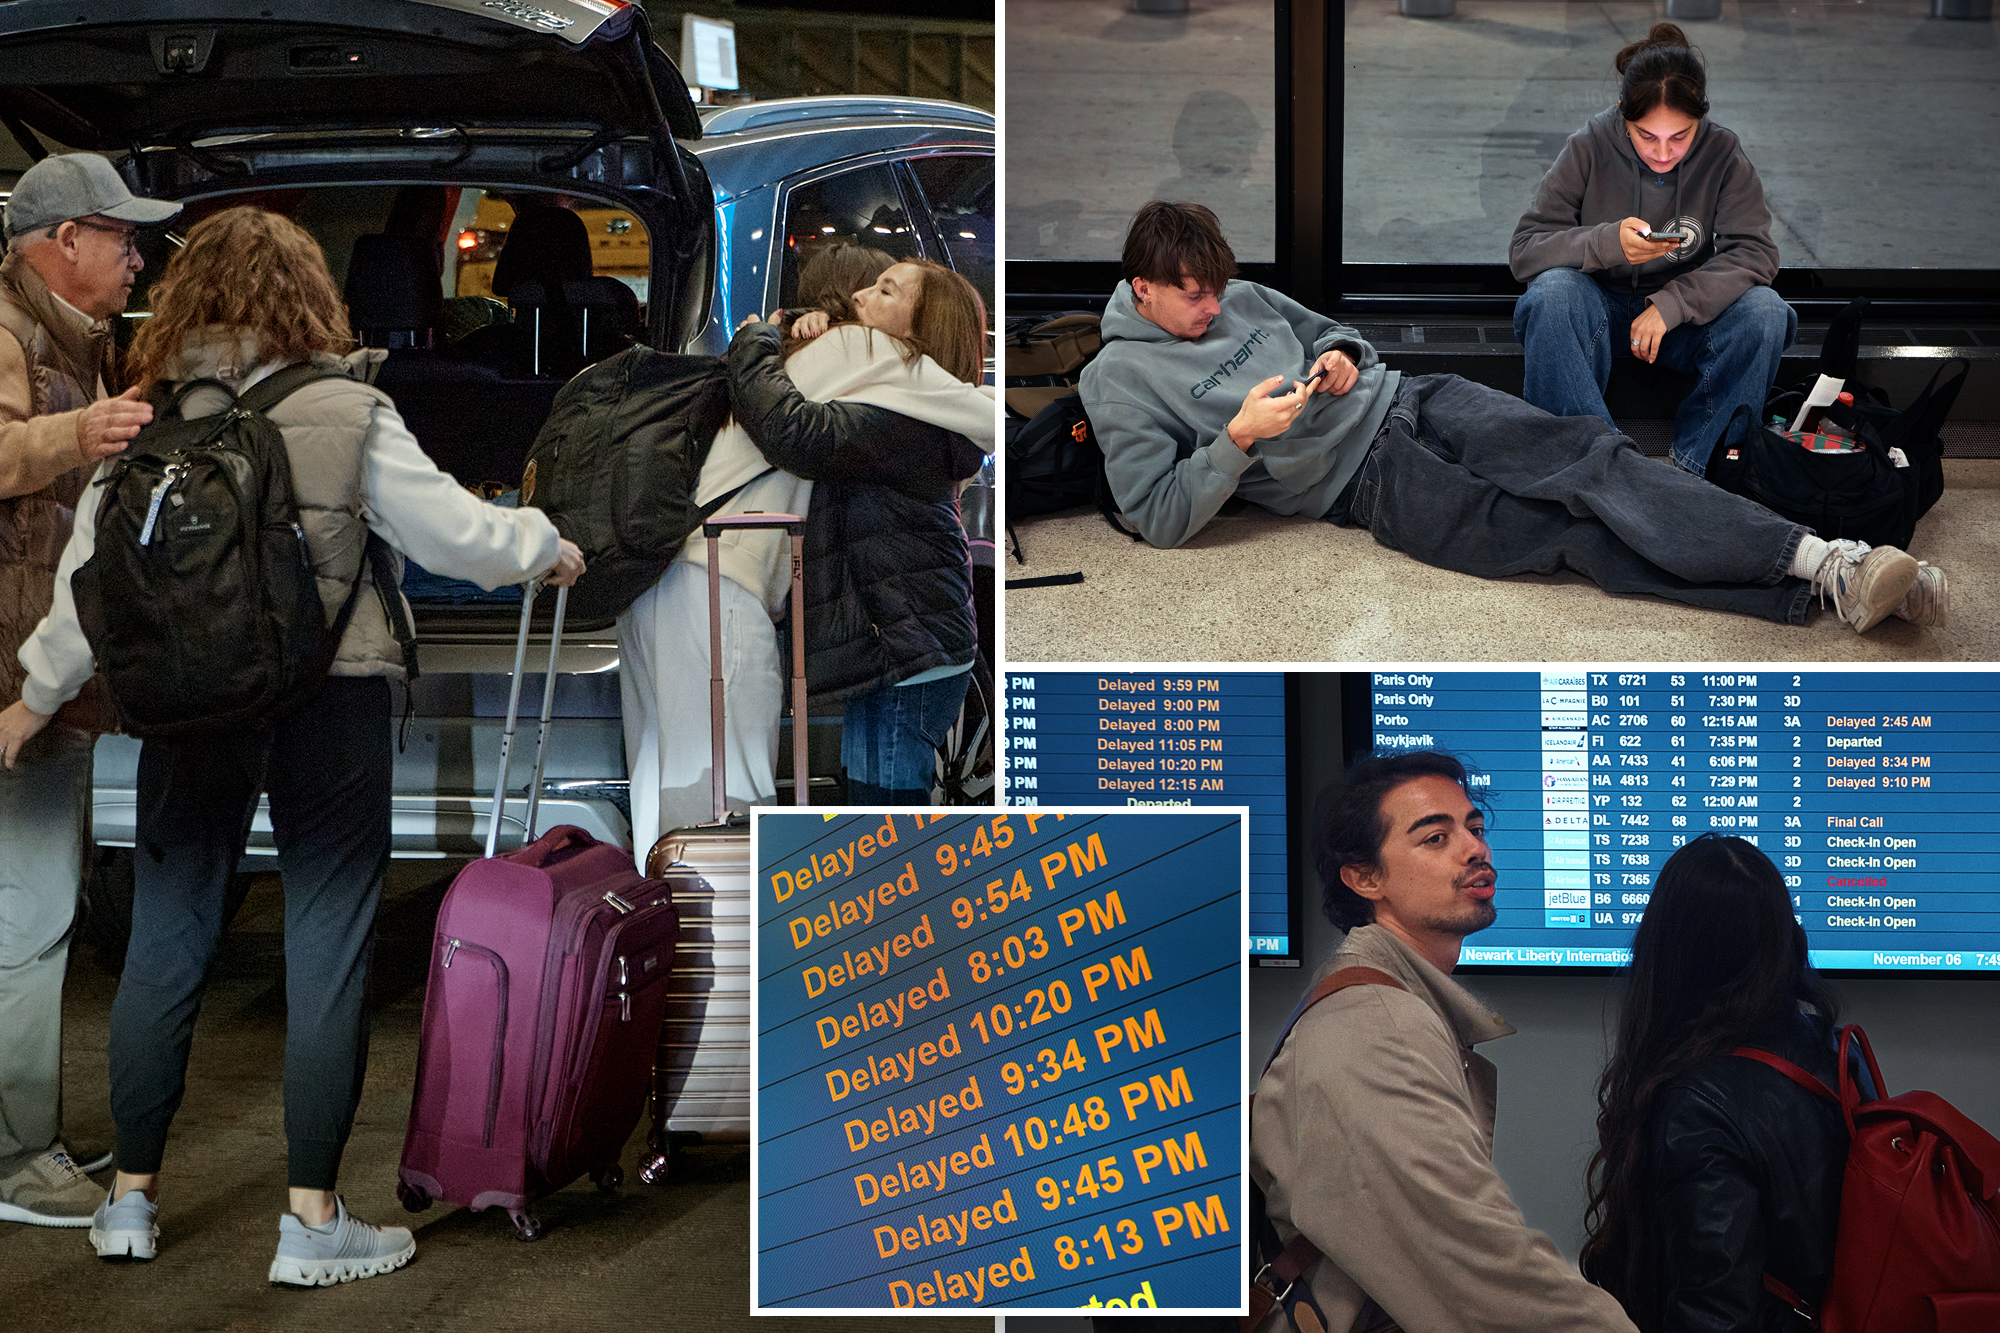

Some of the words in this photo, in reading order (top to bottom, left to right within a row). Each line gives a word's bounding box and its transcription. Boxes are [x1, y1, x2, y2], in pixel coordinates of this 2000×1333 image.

[1190, 329, 1267, 399] carhartt
[1012, 677, 1035, 690] PM
[1098, 678, 1156, 694] Delayed
[1163, 679, 1193, 692] 9:59
[1197, 679, 1220, 692] PM
[1374, 673, 1406, 686] Paris
[1407, 674, 1434, 689] Orly
[1590, 674, 1609, 686] TX
[1618, 674, 1647, 686] 6721
[1670, 674, 1686, 687] 53
[1702, 674, 1735, 687] 11:00
[1737, 674, 1758, 687] PM
[1792, 675, 1801, 687] 2
[1012, 697, 1036, 710] PM
[1098, 698, 1156, 714] Delayed
[1163, 699, 1194, 712] 9:00
[1197, 699, 1220, 712] PM
[1374, 693, 1406, 705] Paris
[1408, 693, 1435, 708] Orly
[1619, 695, 1640, 707] 101
[1670, 695, 1685, 707] 51
[1708, 695, 1735, 707] 7:30
[1737, 695, 1758, 707] PM
[1783, 695, 1801, 707] 3D
[1013, 717, 1036, 730] PM
[1099, 718, 1156, 734] Delayed
[1164, 718, 1194, 731] 8:00
[1198, 719, 1220, 732] PM
[1375, 714, 1409, 726] Porto
[1591, 714, 1611, 726] AC
[1619, 714, 1649, 726] 2706
[1670, 715, 1686, 727] 60
[1701, 715, 1735, 727] 12:15
[1736, 715, 1758, 727] AM
[1783, 715, 1802, 728] 3A
[1827, 715, 1876, 730] Delayed
[1882, 715, 1908, 727] 2:45
[1911, 716, 1932, 727] AM
[1013, 736, 1037, 750] PM
[1097, 738, 1155, 754] Delayed
[1158, 738, 1197, 751] 11:05
[1200, 739, 1223, 751] PM
[1375, 733, 1434, 748] Reykjavik
[1592, 735, 1604, 747] FI
[1619, 735, 1642, 747] 622
[1670, 735, 1685, 747] 61
[1709, 735, 1736, 747] 7:35
[1738, 735, 1758, 748] PM
[1792, 735, 1801, 748] 2
[1826, 735, 1883, 750] Departed
[1014, 756, 1037, 770] PM
[1098, 757, 1155, 773] Delayed
[1159, 758, 1197, 771] 10:20
[1201, 758, 1223, 771] PM
[1591, 754, 1612, 766] AA
[1619, 754, 1649, 766] 7433
[1670, 755, 1685, 767] 41
[1709, 755, 1736, 768] 6:06
[1738, 755, 1758, 768] PM
[1792, 755, 1802, 768] 2
[1827, 756, 1876, 770] Delayed
[1882, 756, 1908, 768] 8:34
[1911, 756, 1931, 767] PM
[1014, 776, 1038, 789] PM
[1098, 777, 1155, 793] Delayed
[1159, 778, 1197, 791] 12:15
[1200, 778, 1224, 791] AM
[1592, 774, 1612, 786] HA
[1619, 774, 1649, 786] 4813
[1671, 775, 1686, 787] 41
[1709, 775, 1736, 788] 7:29
[1738, 775, 1758, 788] PM
[1792, 775, 1802, 788] 2
[1827, 776, 1876, 790] Delayed
[1882, 776, 1908, 788] 9:10
[1911, 776, 1931, 788] PM
[1592, 794, 1611, 807] YP
[1620, 795, 1643, 807] 132
[1671, 795, 1687, 807] 62
[1702, 795, 1735, 808] 12:00
[1737, 795, 1758, 808] AM
[1792, 795, 1802, 808] 2
[1555, 817, 1589, 825] DELTA
[1593, 814, 1611, 826] DL
[1620, 814, 1650, 826] 7442
[1671, 815, 1687, 827] 68
[1709, 815, 1736, 827] 8:00
[1738, 815, 1758, 828] PM
[1784, 815, 1802, 828] 3A
[1827, 816, 1857, 828] Final
[1859, 816, 1883, 828] Call
[1593, 833, 1611, 846] TS
[1620, 834, 1650, 846] 7238
[1671, 835, 1686, 847] 51
[1784, 835, 1802, 848] 3D
[1826, 836, 1881, 848] Check-In
[1883, 836, 1917, 851] Open
[771, 816, 899, 904] Delayed
[1593, 853, 1611, 865] TS
[1620, 853, 1650, 866] 7638
[1784, 855, 1802, 867] 3D
[1826, 856, 1881, 868] Check-In
[1883, 856, 1917, 871] Open
[789, 862, 919, 949] Delayed
[935, 815, 1015, 876] 9:45
[1593, 873, 1611, 885] TS
[1621, 873, 1651, 885] 7365
[1784, 875, 1802, 888] 3D
[1827, 876, 1887, 887] Cancelled
[1548, 892, 1587, 907] jetBlue
[1594, 892, 1612, 905] B6
[1621, 893, 1651, 905] 6660
[1826, 895, 1881, 908] Check-In
[1883, 896, 1917, 910] Open
[802, 914, 935, 999] Delayed
[951, 870, 1032, 930] 9:54
[1040, 832, 1108, 890] PM
[1594, 912, 1614, 924] UA
[1826, 915, 1881, 927] Check-In
[1883, 915, 1916, 930] Open
[1256, 938, 1279, 951] PM
[1465, 948, 1515, 962] Newark
[1517, 949, 1563, 965] Liberty
[1566, 949, 1634, 963] Internatio
[1873, 952, 1943, 966] November
[1944, 953, 1962, 966] 06
[816, 967, 951, 1049] Delayed
[968, 926, 1049, 984] 8:03
[1058, 890, 1128, 947] PM
[825, 1023, 961, 1103] Delayed
[970, 979, 1073, 1045] 10:20
[1081, 946, 1153, 1002] PM
[844, 1076, 984, 1152] Delayed
[1001, 1039, 1086, 1096] 9:34
[1095, 1008, 1167, 1063] PM
[854, 1134, 995, 1207] Delayed
[1004, 1096, 1111, 1158] 10:48
[1119, 1067, 1194, 1121] PM
[874, 1189, 1018, 1259] Delayed
[1036, 1156, 1124, 1211] 9:45
[1133, 1131, 1208, 1184] PM
[889, 1247, 1036, 1307] Delayed
[1056, 1219, 1145, 1271] 8:13
[1152, 1195, 1230, 1246] PM
